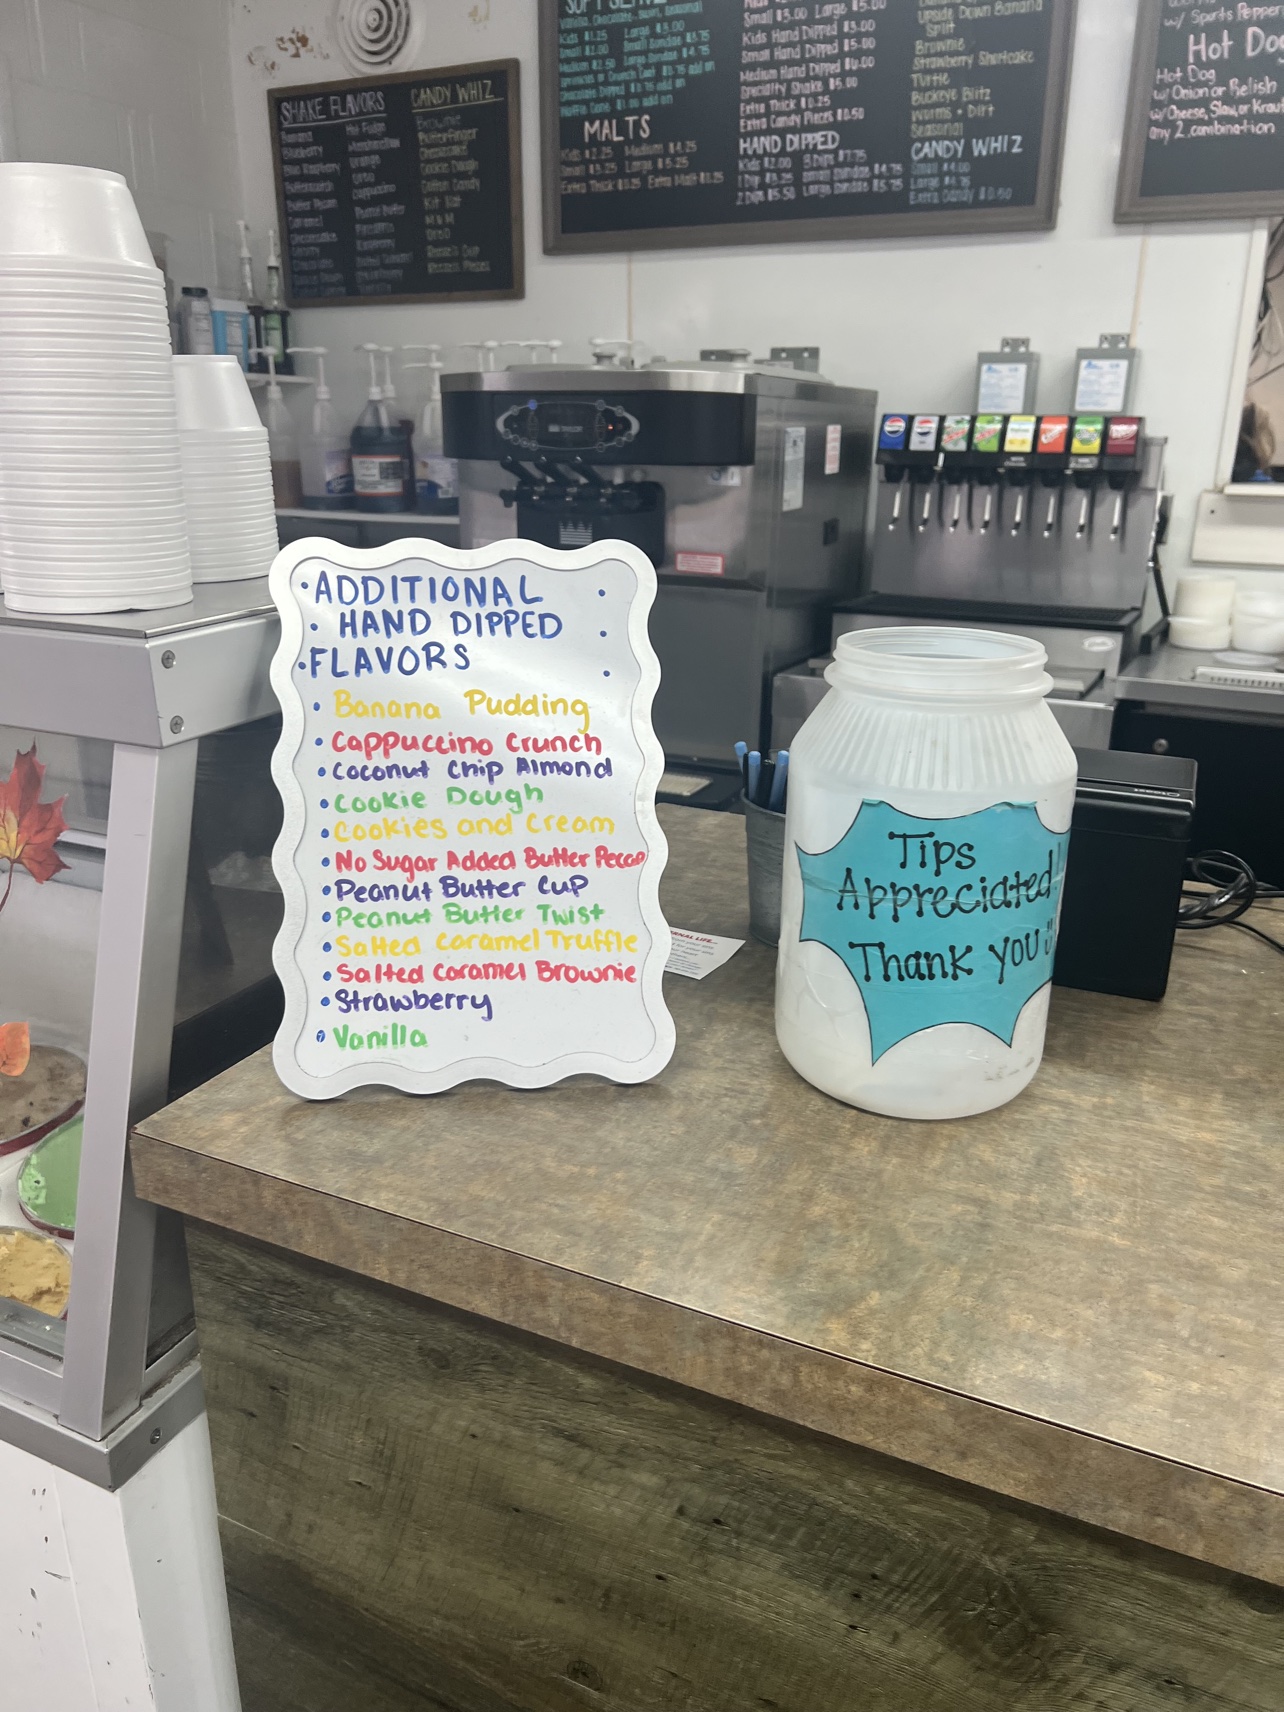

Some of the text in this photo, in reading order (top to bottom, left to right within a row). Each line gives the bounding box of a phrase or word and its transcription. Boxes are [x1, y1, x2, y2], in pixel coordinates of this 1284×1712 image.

[744, 9, 773, 27] Small
[815, 3, 848, 19] Large
[959, 5, 991, 19] Down
[994, 0, 1043, 16] Banana
[1191, 7, 1233, 26] Sports
[742, 30, 767, 46] Kids
[771, 27, 799, 43] Hand
[802, 20, 838, 40] Dipped
[915, 38, 965, 55] Brownie
[1188, 29, 1233, 63] Hot
[742, 49, 770, 63] Small
[774, 45, 801, 60] Hand
[805, 39, 839, 58] Dipped
[913, 49, 1034, 70] Strawberry Shortcake
[740, 67, 778, 82] Medium
[780, 64, 806, 79] Hand
[809, 59, 841, 77] Dipped
[911, 72, 950, 87] Turtle
[1156, 65, 1216, 85] Hot Dog
[411, 80, 494, 108] CANDY WHIZ
[962, 86, 991, 101] Blitz
[1172, 84, 1209, 100] Onion
[1211, 86, 1226, 98] or
[1229, 76, 1277, 98] Relish
[281, 91, 386, 126] SHAKE FLAVORS
[770, 99, 796, 112] Thick
[584, 114, 651, 143] MALTS
[739, 131, 840, 155] HAND DIPPED
[911, 135, 1023, 160] CANDY WHIZ
[315, 570, 544, 608] ADDITIONAL
[339, 609, 562, 639] HAND DIPPED
[310, 641, 470, 678] FLAVORS
[333, 688, 590, 734] Banana Pudding
[332, 731, 602, 760] Cappuccino Crunch
[332, 757, 612, 784] Coconut Chip Almond
[334, 783, 544, 815] Cookie Dough
[334, 812, 615, 843] Cookies and Cream
[335, 849, 366, 873] No
[372, 849, 438, 883] Sugar
[447, 849, 516, 872] Added
[523, 846, 590, 869] Butter
[888, 831, 976, 877] Tips
[334, 878, 433, 903] Peanut
[439, 875, 526, 899] Butter
[335, 902, 606, 929] Peanut Butter Twist
[335, 928, 639, 957] Salted Caramel Truffle
[336, 960, 637, 985] Salted Caramel Brownie
[848, 940, 974, 982] Thank
[335, 988, 493, 1022] Strawberry
[332, 1022, 429, 1051] Vanilla
